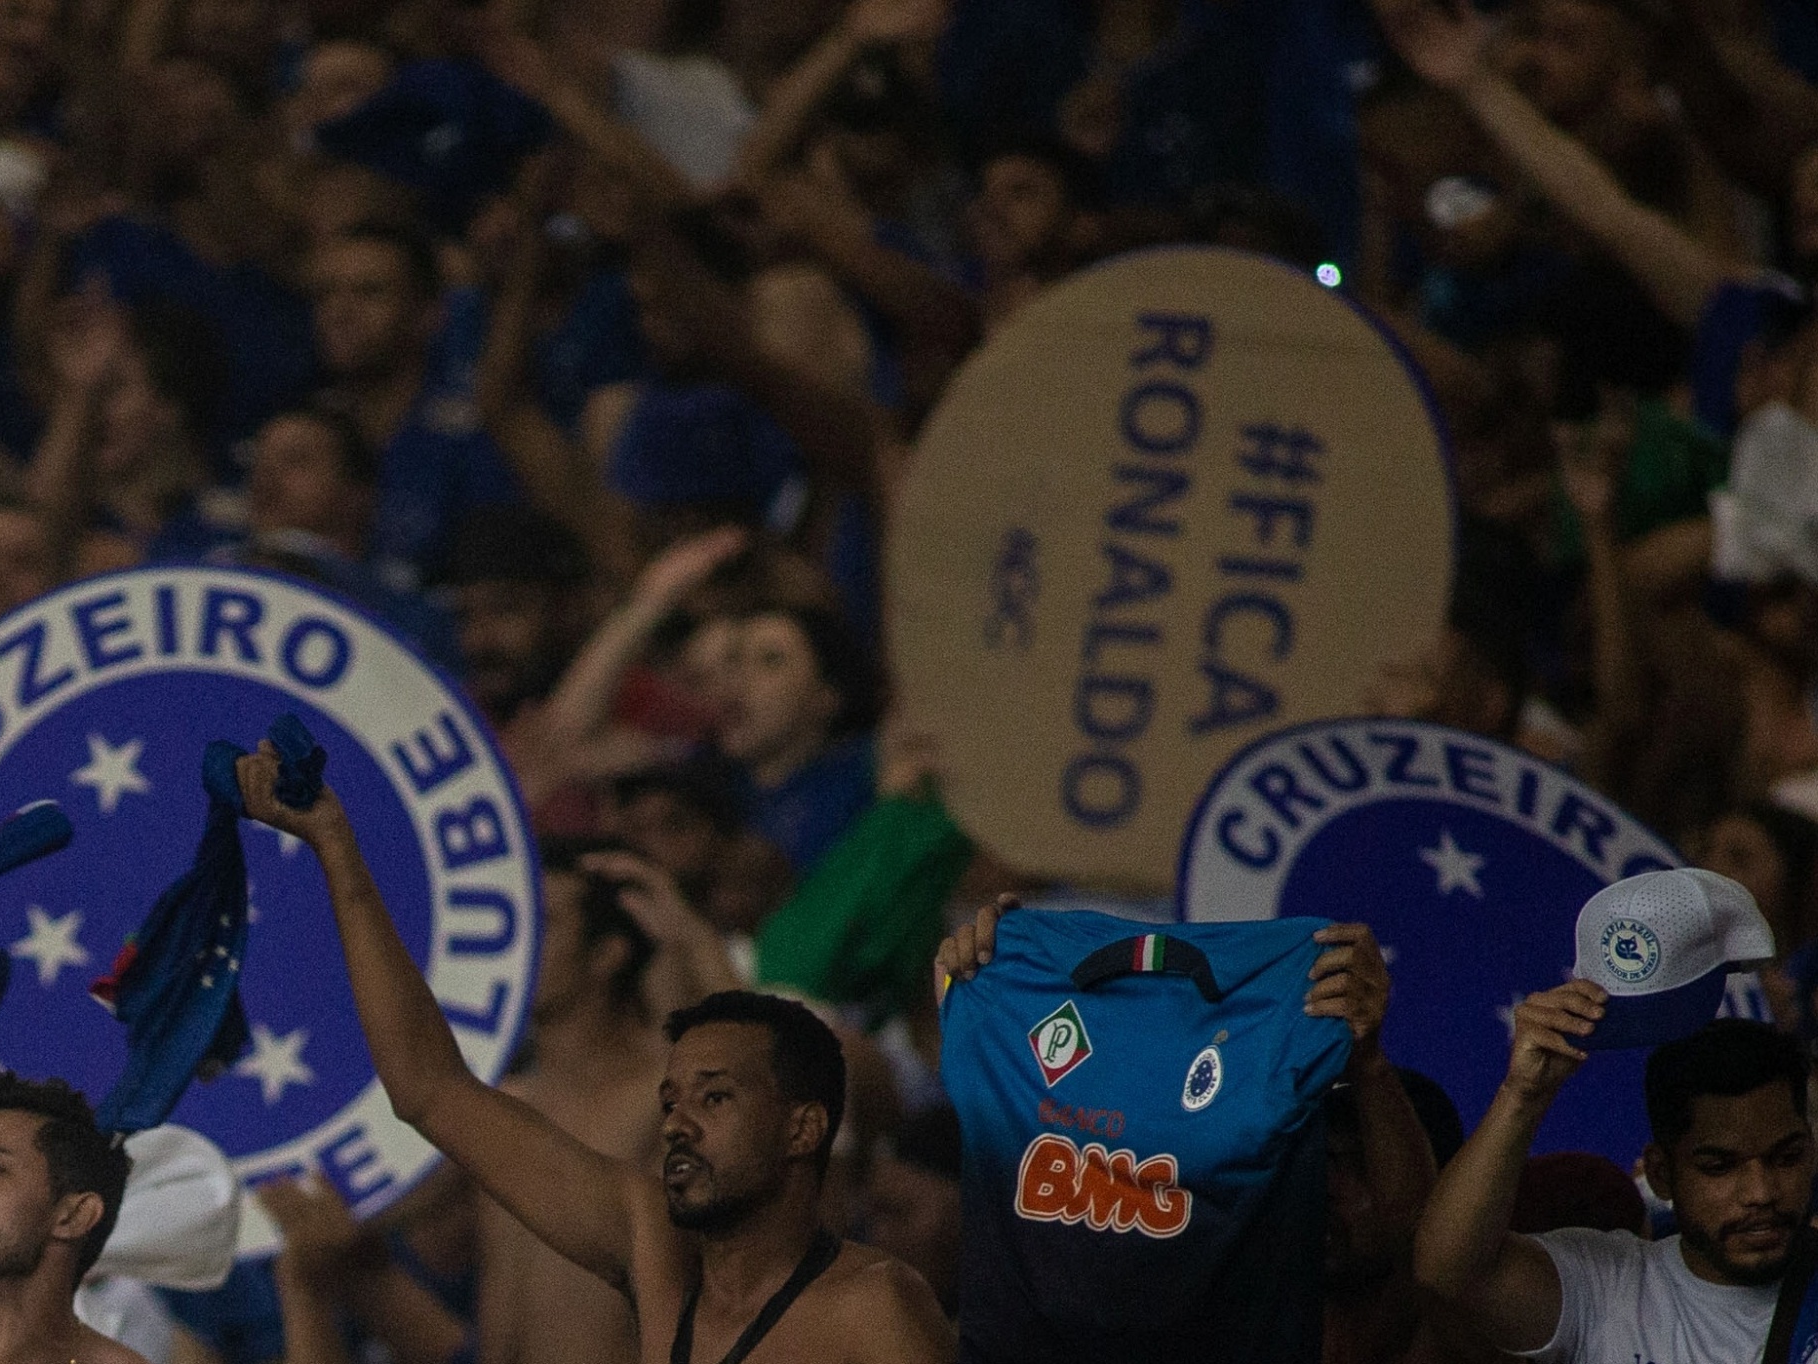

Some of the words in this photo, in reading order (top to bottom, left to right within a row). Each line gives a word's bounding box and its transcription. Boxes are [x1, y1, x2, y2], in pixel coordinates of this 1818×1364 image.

[1060, 312, 1214, 829] RONALDO
[1191, 423, 1325, 736] #FICA
[392, 712, 515, 1034] LUBE
[1630, 922, 1656, 947] AZUL
[1014, 1132, 1193, 1239] BMG
[1038, 1097, 1125, 1139] BANCO
